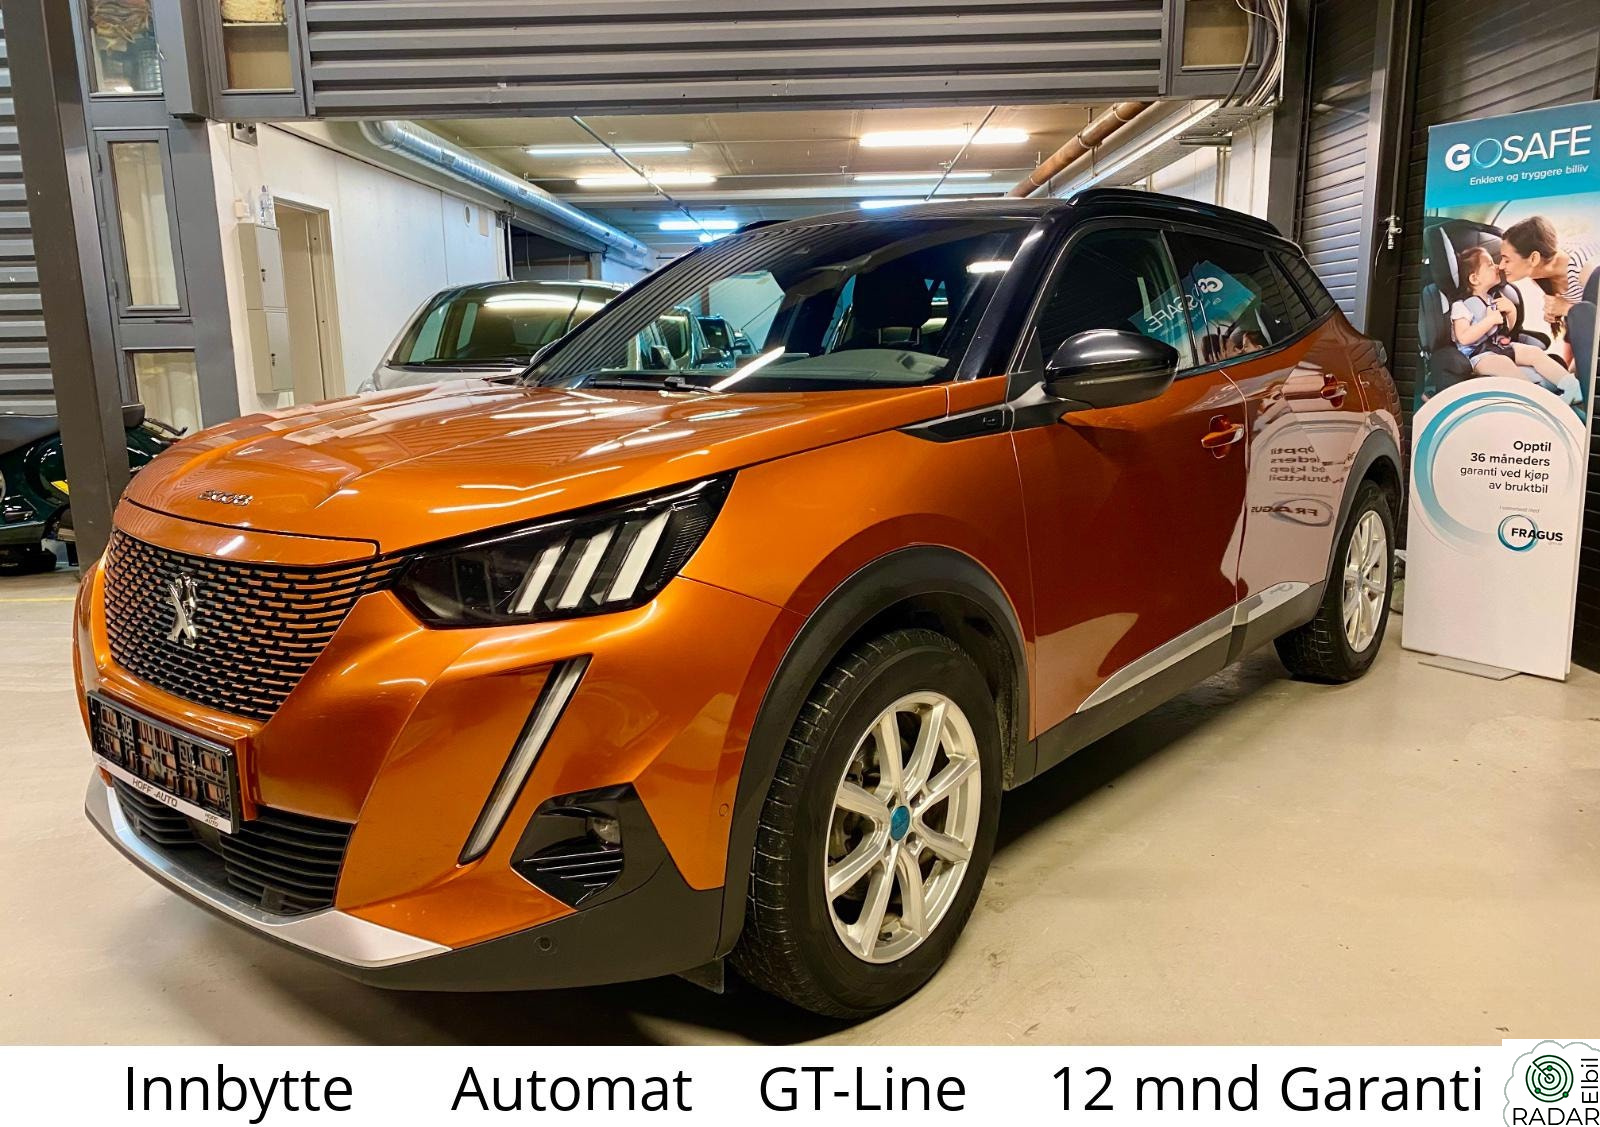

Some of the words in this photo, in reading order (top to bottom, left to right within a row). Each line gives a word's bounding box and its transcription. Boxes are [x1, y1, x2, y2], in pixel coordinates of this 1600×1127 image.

[1445, 125, 1592, 171] GOSAFE
[1470, 176, 1504, 185] Enklere
[1506, 174, 1519, 183] og
[1521, 168, 1563, 181] tryggere
[1565, 164, 1589, 175] billiv
[1513, 440, 1552, 453] Opptil
[1470, 452, 1486, 463] 36
[1489, 453, 1551, 467] måneders
[1460, 467, 1497, 477] garanti
[1500, 469, 1521, 478] ved
[1524, 469, 1549, 482] kjøp
[1488, 482, 1502, 490] av
[1504, 481, 1549, 494] bruktbil
[1511, 527, 1563, 541] FRAGUS
[132, 777, 152, 793] HOFF
[154, 792, 178, 808] AUTO
